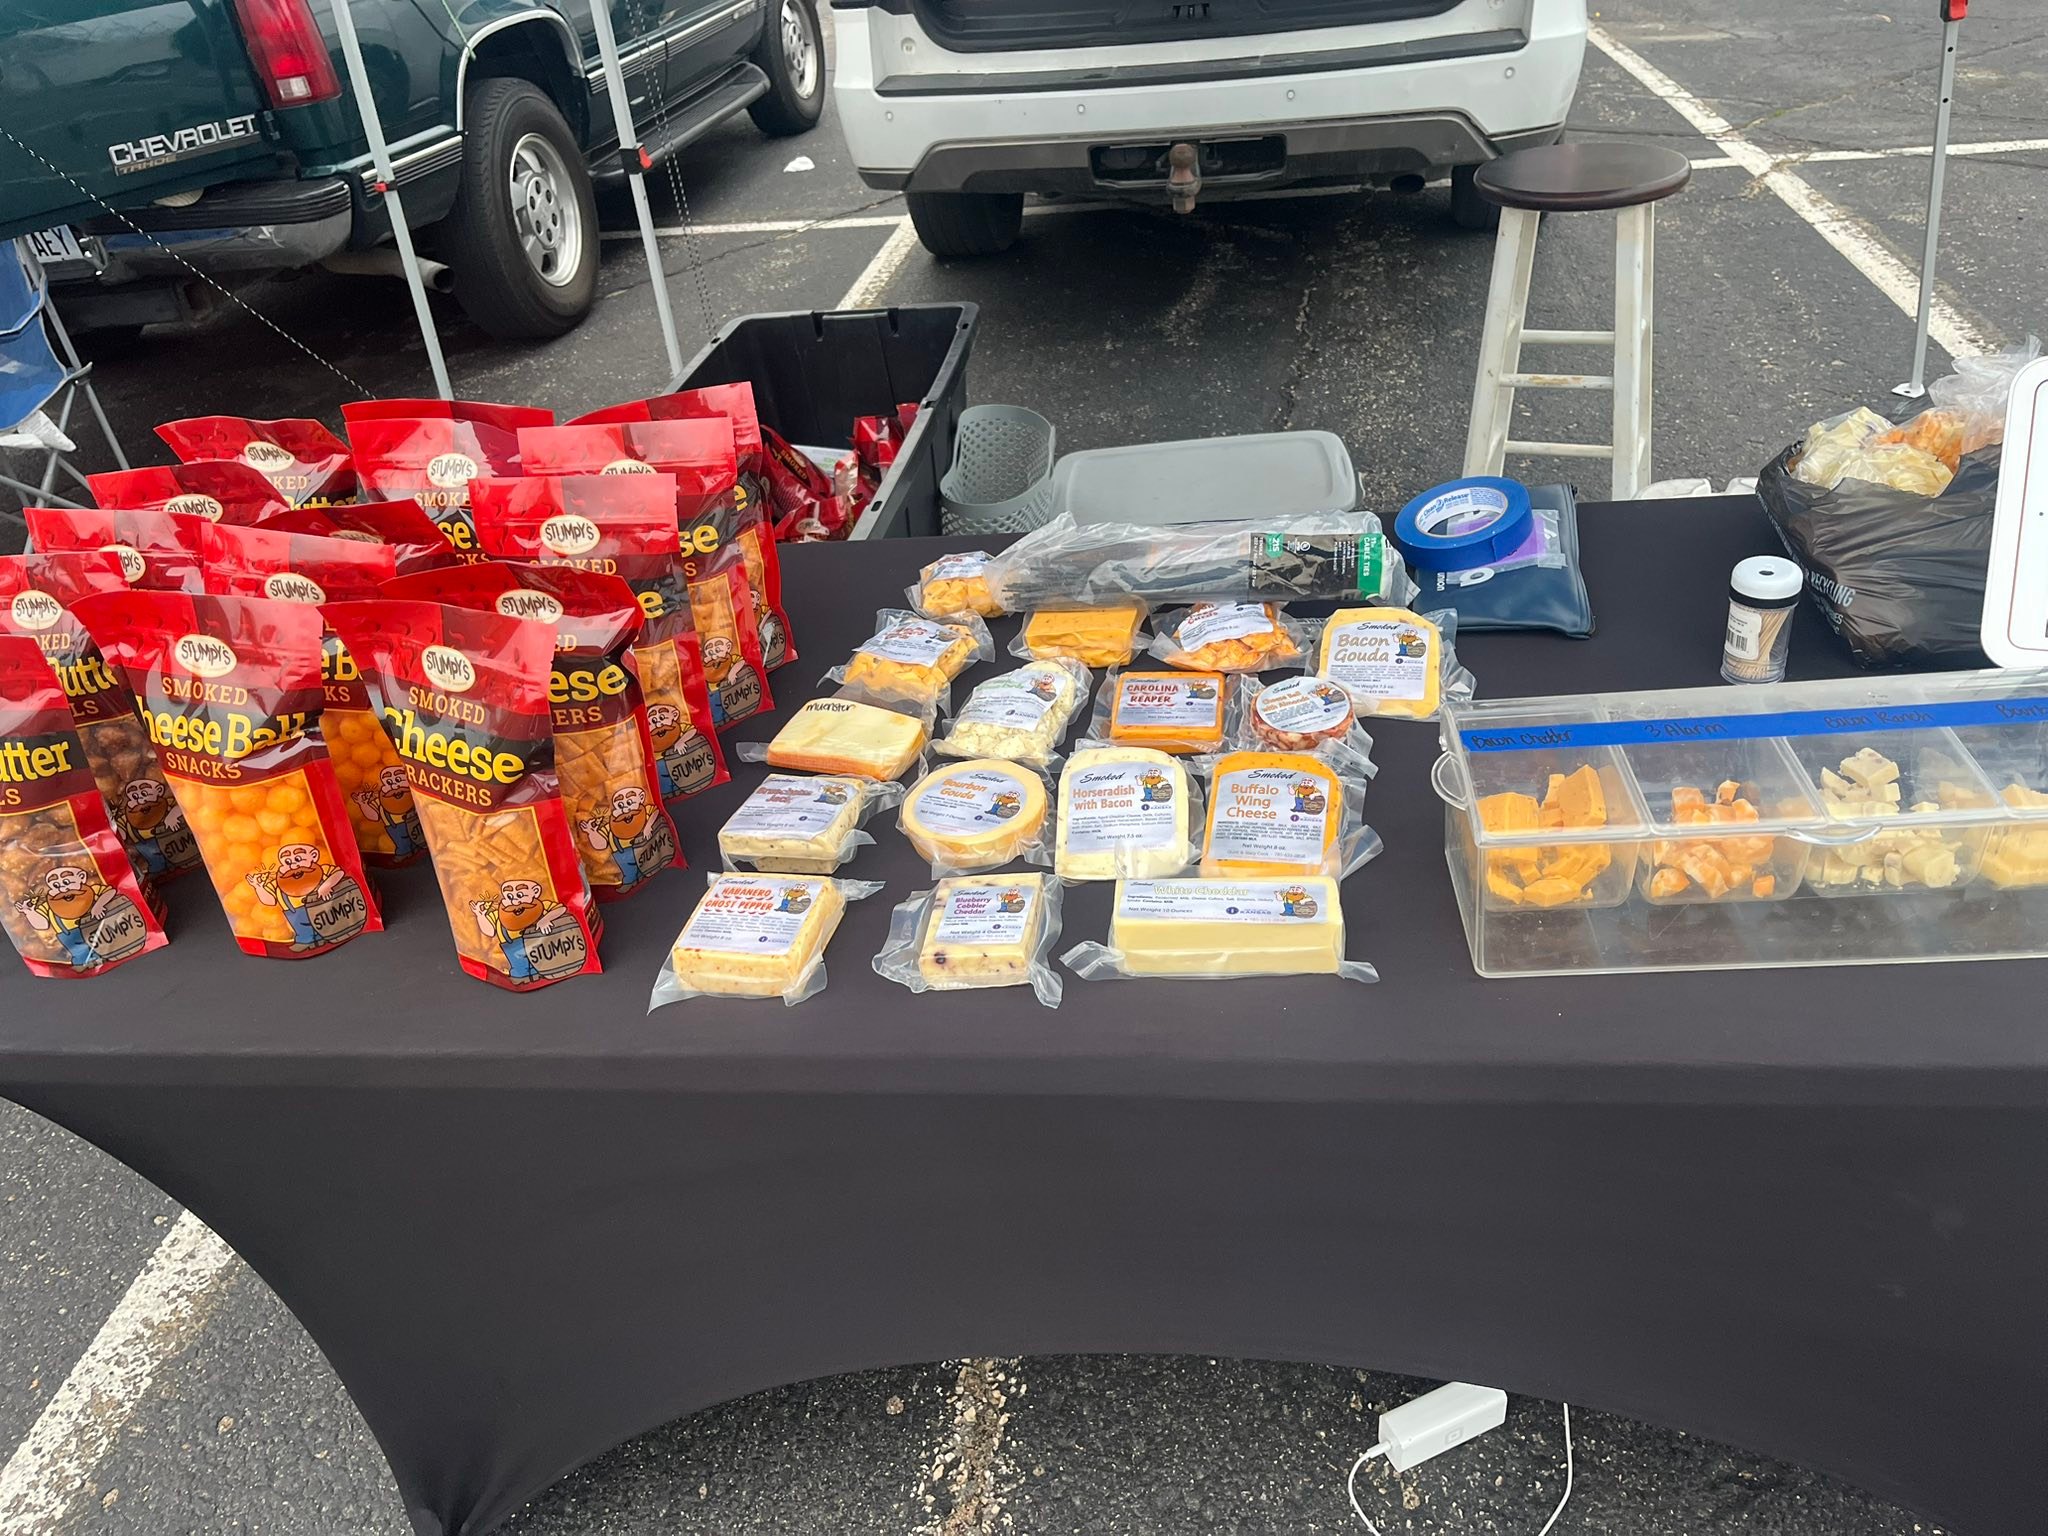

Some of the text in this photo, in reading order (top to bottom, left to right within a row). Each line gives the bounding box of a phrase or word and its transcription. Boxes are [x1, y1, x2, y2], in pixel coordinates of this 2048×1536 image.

[108, 114, 257, 167] CHEVROLET
[118, 155, 177, 174] TAHOE
[415, 492, 471, 507] SMOKE
[546, 523, 594, 543] STUMPY'S
[1363, 537, 1371, 560] CABLE
[270, 579, 321, 601] STUMPY'S
[16, 597, 59, 619] STUMPY'S
[502, 595, 557, 617] STUMPY'S
[1357, 622, 1401, 631] Smoked
[1338, 634, 1390, 648] Bacon
[181, 640, 231, 666] STUMPY'S
[1334, 648, 1389, 663] Gouda
[426, 651, 470, 681] STUMPY'S
[162, 677, 248, 706] SMOKED
[547, 664, 628, 703] ese
[1127, 684, 1179, 693] CAROLINA
[408, 686, 485, 725] SMOKED
[723, 684, 760, 711] STUMPY'S
[1130, 695, 1171, 703] REAPER
[136, 696, 222, 757] heese
[1644, 723, 1730, 738] 3 Alarm
[384, 706, 525, 784] Cheese
[0, 740, 72, 783] tter
[166, 752, 242, 779] SNACKS
[671, 753, 715, 782] STUMPY'S
[405, 763, 493, 807] RACKERS
[942, 778, 988, 792] Bourbon
[1080, 772, 1126, 784] Smoked
[1248, 770, 1298, 780] Smoked
[940, 787, 976, 800] Gouda
[1072, 785, 1136, 798] Horseradish
[1231, 783, 1280, 795] Buffalo
[1074, 799, 1133, 810] with Bacon
[1236, 796, 1271, 809] Wing
[1226, 807, 1277, 819] Cheese
[722, 887, 772, 897] HABANERO
[1154, 885, 1249, 896] White Cheddar
[314, 897, 366, 932] STUMPY'S
[705, 900, 774, 910] GHOST PEPPER
[88, 913, 144, 949] STUMPY'S
[529, 935, 585, 963] STUMPY'S
